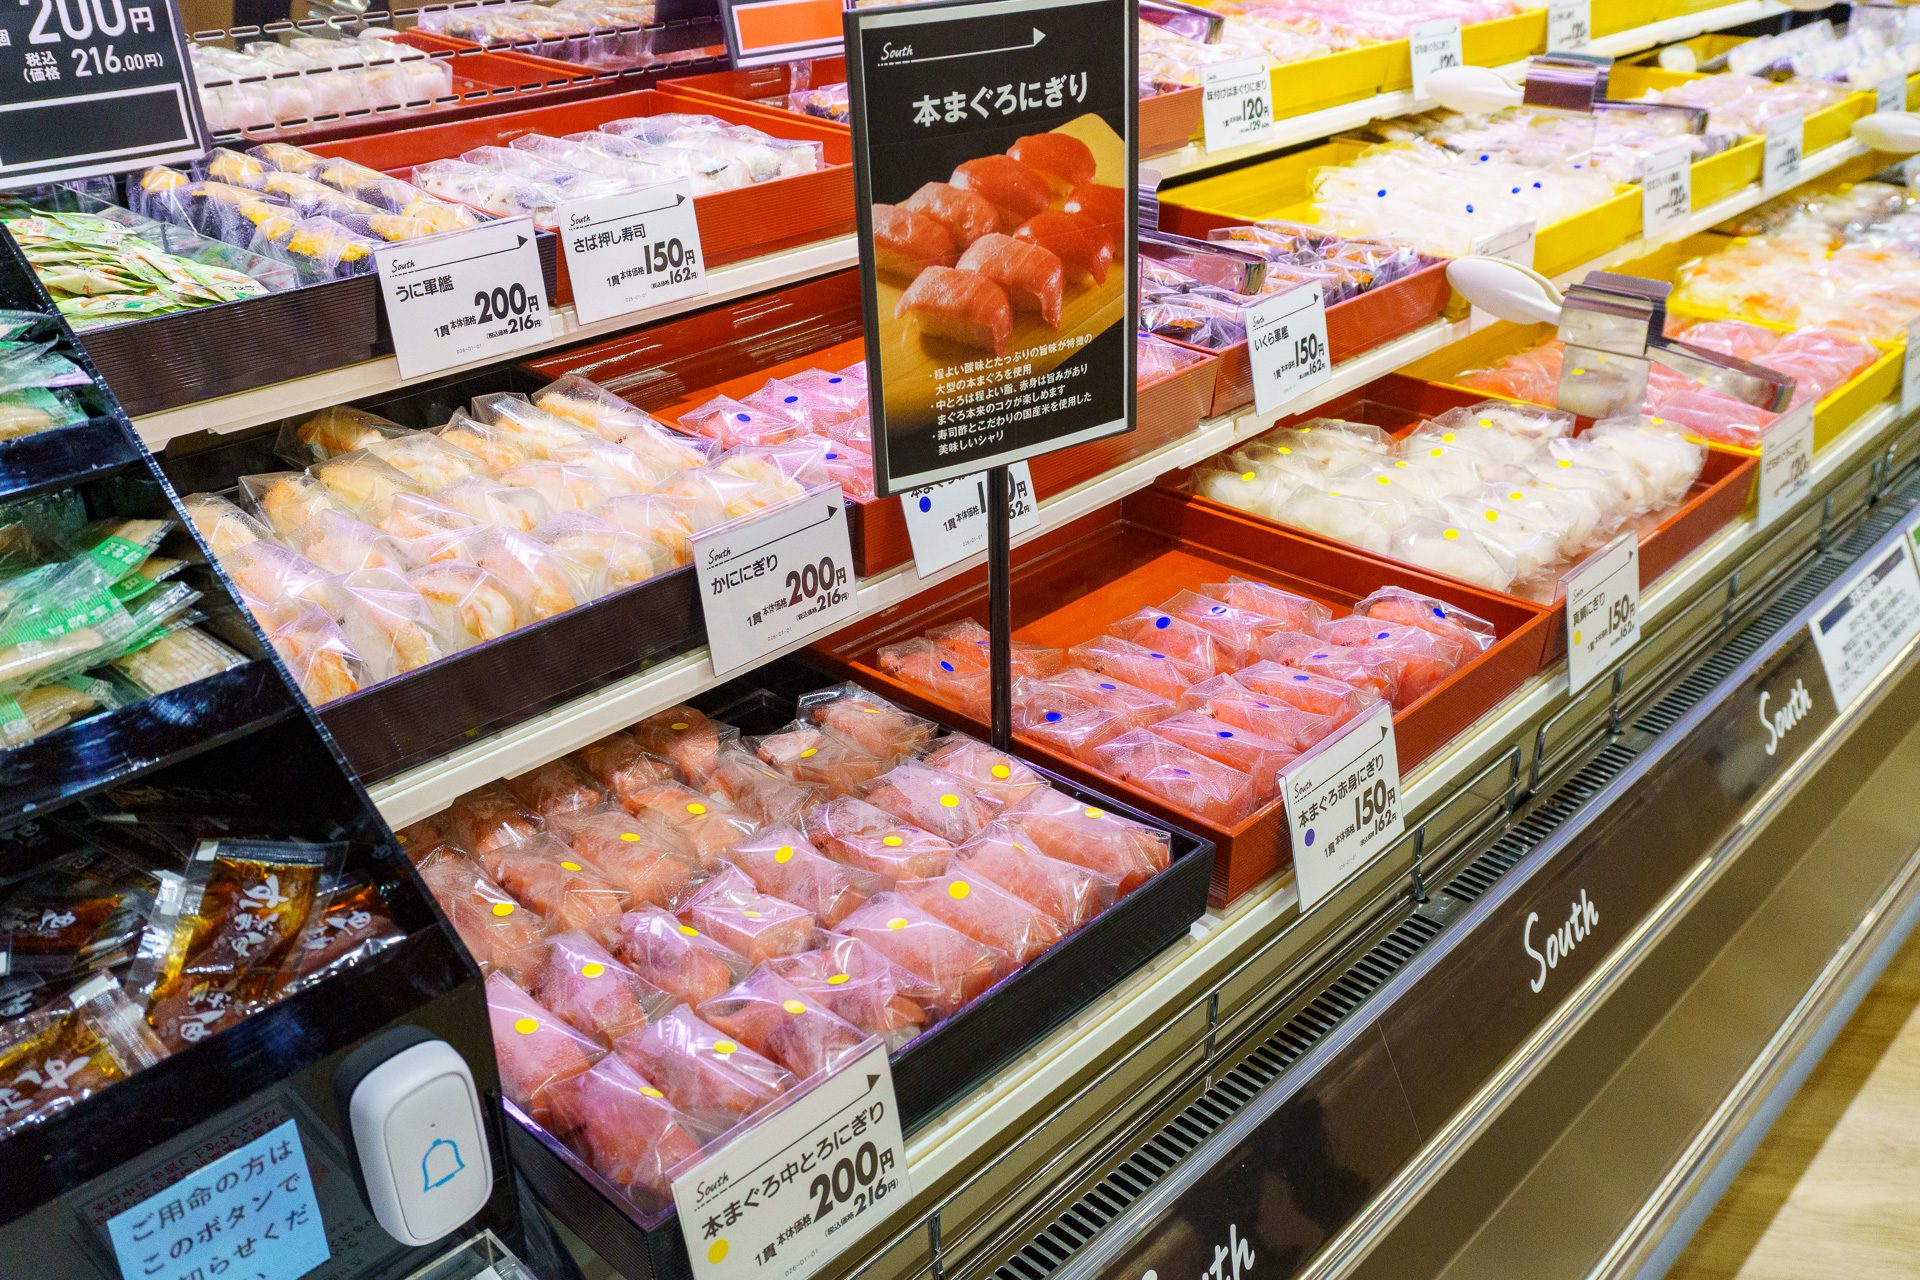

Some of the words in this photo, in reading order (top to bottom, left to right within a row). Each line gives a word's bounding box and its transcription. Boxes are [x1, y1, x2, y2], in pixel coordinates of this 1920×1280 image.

[880, 42, 914, 61] South
[912, 72, 1088, 127] 本まぐろにぎり
[570, 213, 591, 227] South
[573, 223, 647, 253] さば押し寿司
[391, 259, 416, 274] South
[396, 275, 454, 302] うに軍艦
[935, 364, 1032, 396] 大型の本まぐろを使用
[937, 384, 1066, 426] まぐろ本来のコクが楽しめます
[938, 431, 1005, 455] 美味しいシャリ
[708, 547, 731, 565] South
[711, 554, 778, 595] かににぎり
[1760, 678, 1812, 755] South
[1294, 778, 1312, 798] South
[1298, 753, 1384, 828] 本まぐろ赤身にぎり
[1524, 888, 1599, 993] South
[702, 1101, 884, 1240] 本まぐろ中とろにぎり
[132, 1140, 294, 1242] ご用命の方は
[696, 1172, 730, 1204] South
[144, 1173, 301, 1276] このボタンで
